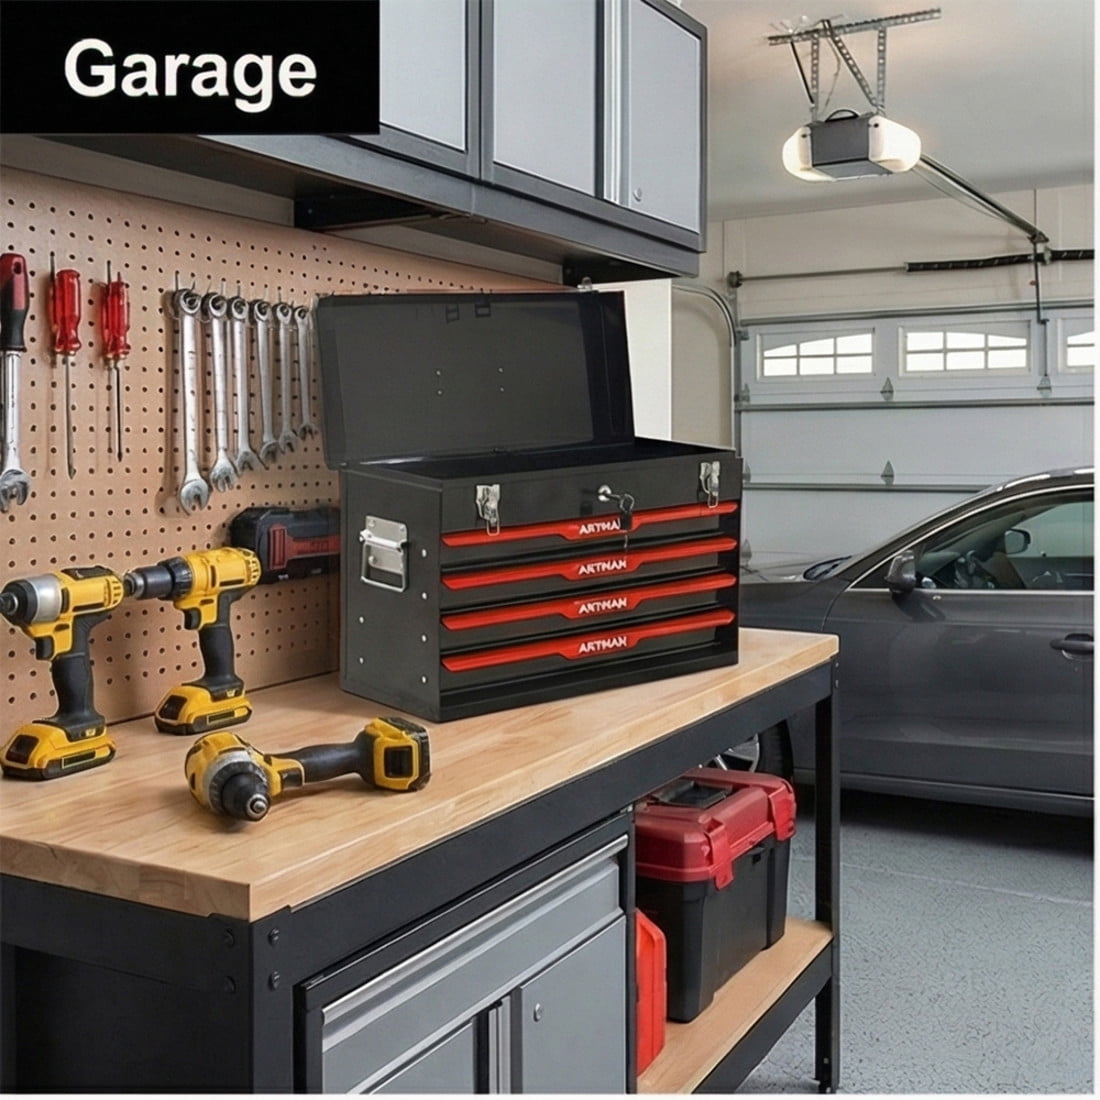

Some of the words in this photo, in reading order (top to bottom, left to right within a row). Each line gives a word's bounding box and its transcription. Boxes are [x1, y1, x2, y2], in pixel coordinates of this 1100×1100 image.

[578, 518, 622, 536] ARTMA
[578, 558, 627, 576] ARTMAN
[578, 597, 627, 615] ARTMAN
[578, 635, 627, 654] ARTMAN
